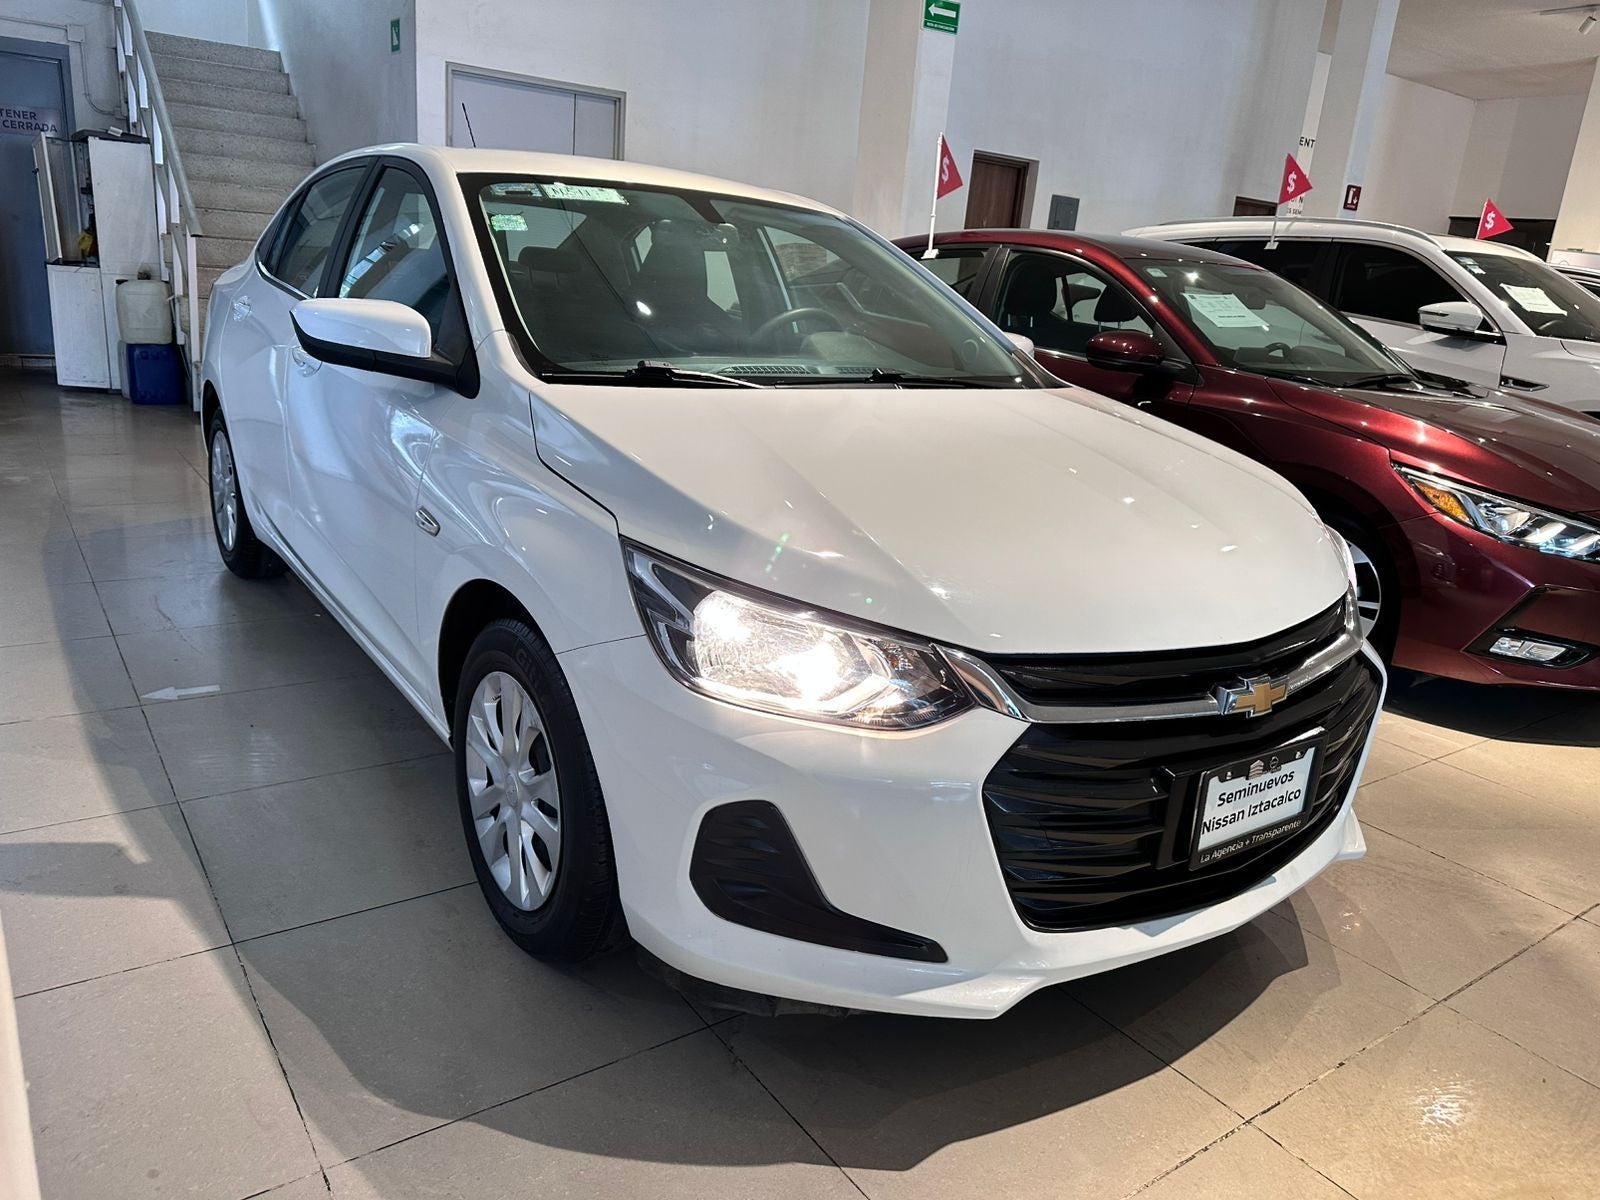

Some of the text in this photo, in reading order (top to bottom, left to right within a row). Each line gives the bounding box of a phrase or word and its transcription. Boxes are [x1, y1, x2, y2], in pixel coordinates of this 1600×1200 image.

[2, 119, 58, 133] CERRADA
[1217, 770, 1295, 808] Seminuevos
[1201, 788, 1301, 835] Nissan Iztacalco
[1200, 854, 1210, 863] La
[1211, 840, 1244, 860] Agencia
[1251, 819, 1302, 845] Transparente
